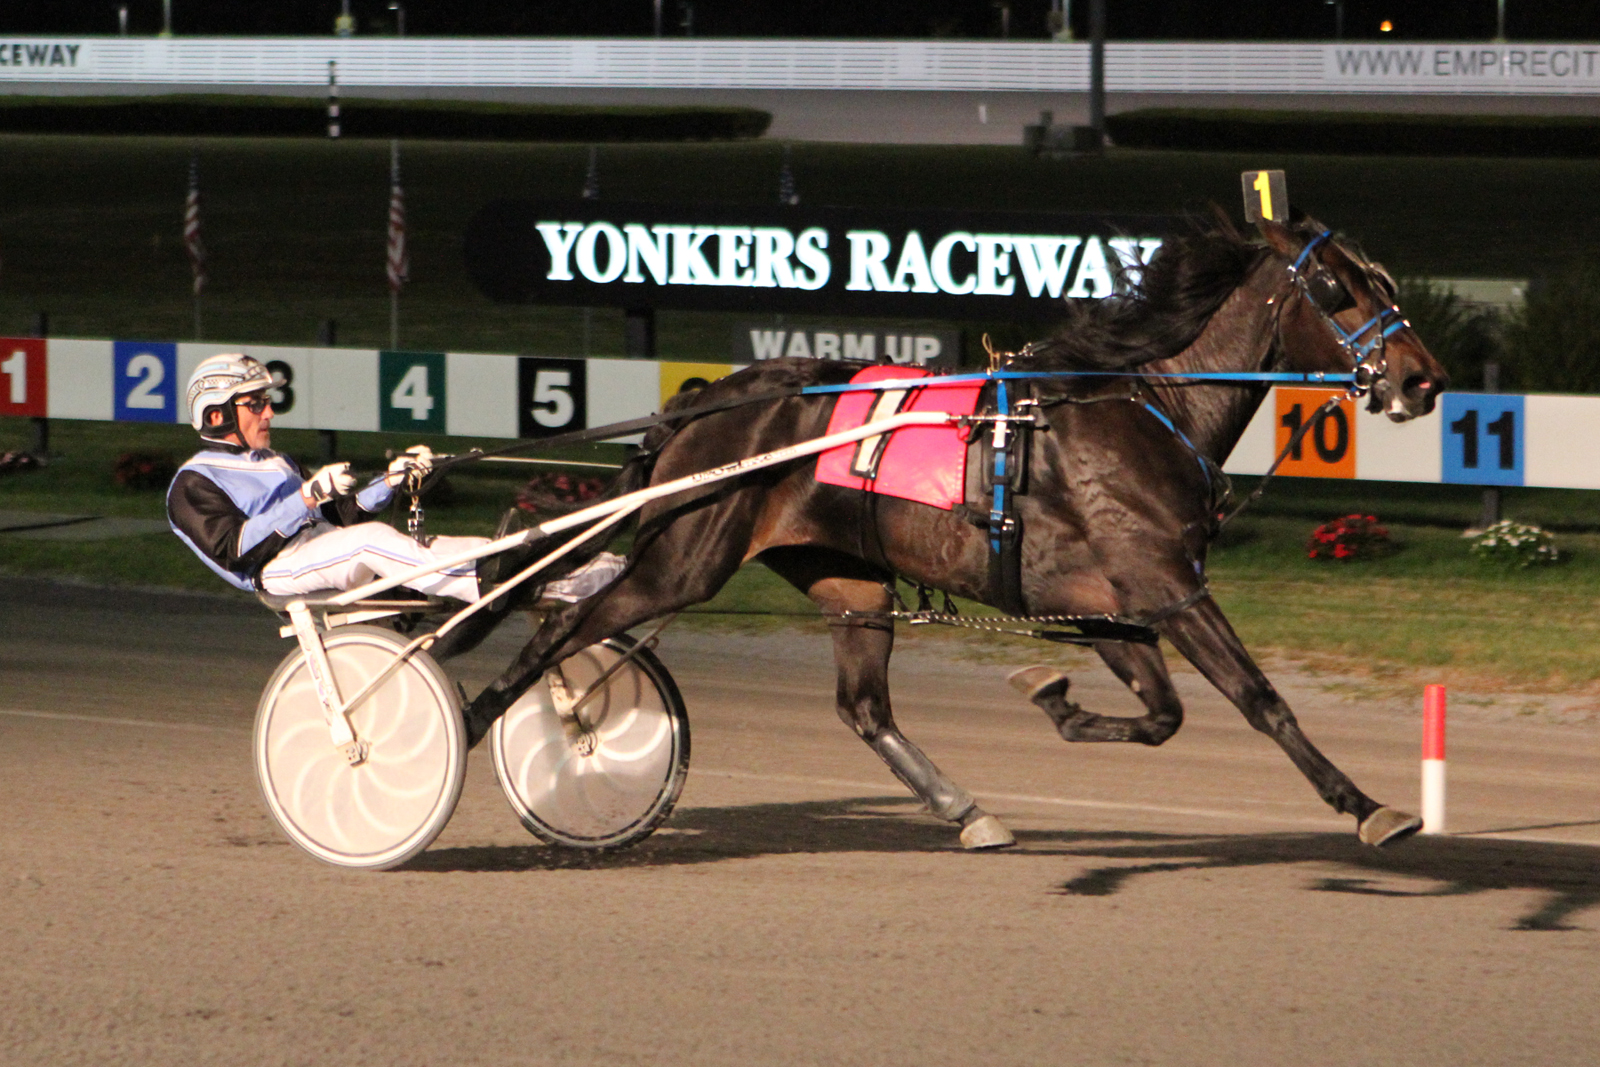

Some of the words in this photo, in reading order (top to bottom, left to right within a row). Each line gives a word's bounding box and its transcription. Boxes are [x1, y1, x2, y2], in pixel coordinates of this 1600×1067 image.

[0, 44, 80, 66] CEWAY
[1253, 170, 1273, 221] 1
[535, 221, 831, 290] YONKERS
[845, 229, 1162, 299] RACEWAY
[750, 330, 876, 361] WARM
[885, 335, 941, 366] UP
[1, 351, 26, 403] 1
[126, 354, 165, 409] 2
[263, 360, 295, 415] 3
[391, 365, 434, 421] 4
[530, 370, 575, 428] 5
[1281, 402, 1349, 464] 10
[1451, 410, 1515, 470] 11
